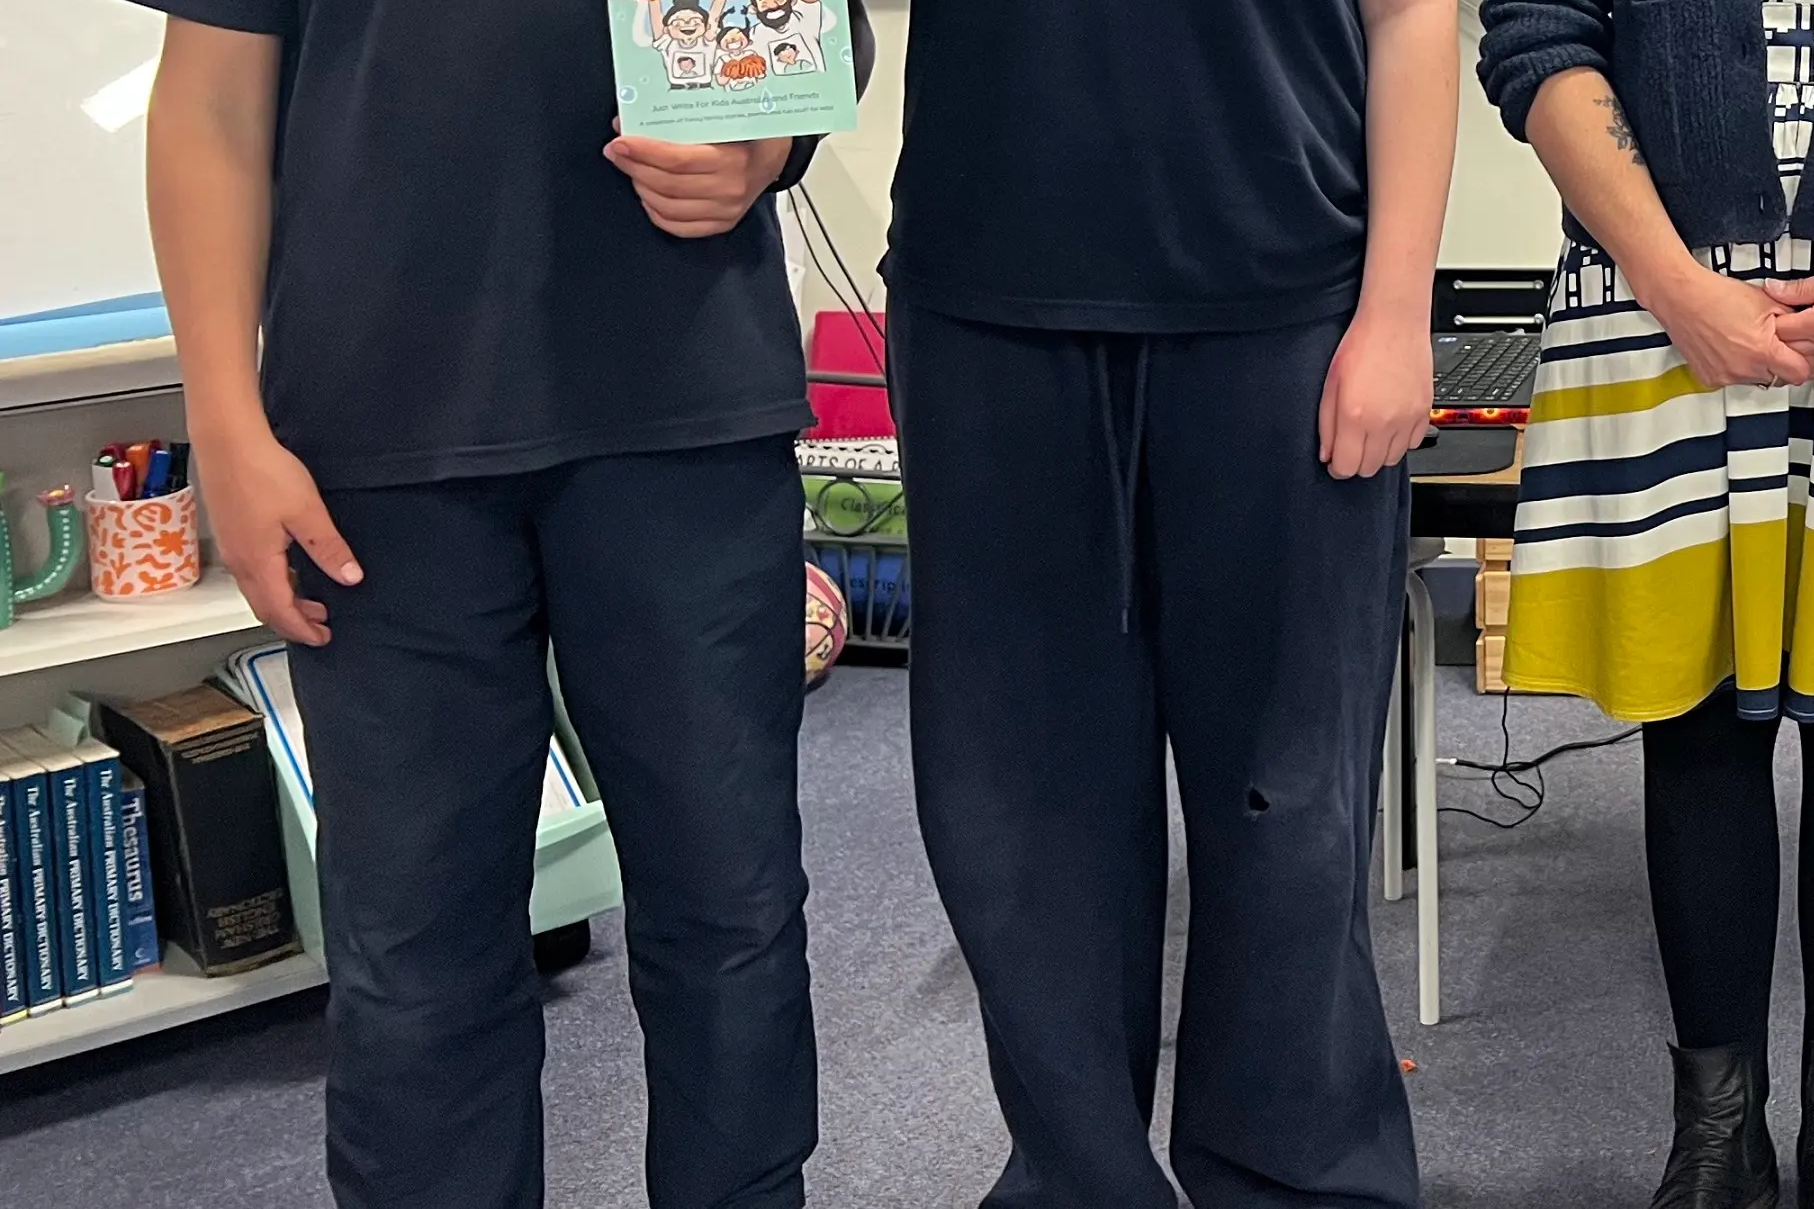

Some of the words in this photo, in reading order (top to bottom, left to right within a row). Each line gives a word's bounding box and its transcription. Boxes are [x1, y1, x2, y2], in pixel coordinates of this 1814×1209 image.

[101, 793, 117, 849] Australian
[122, 797, 145, 903] Thesaurus
[104, 850, 118, 903] PRIMARY
[107, 904, 124, 971] DICTIONARY
